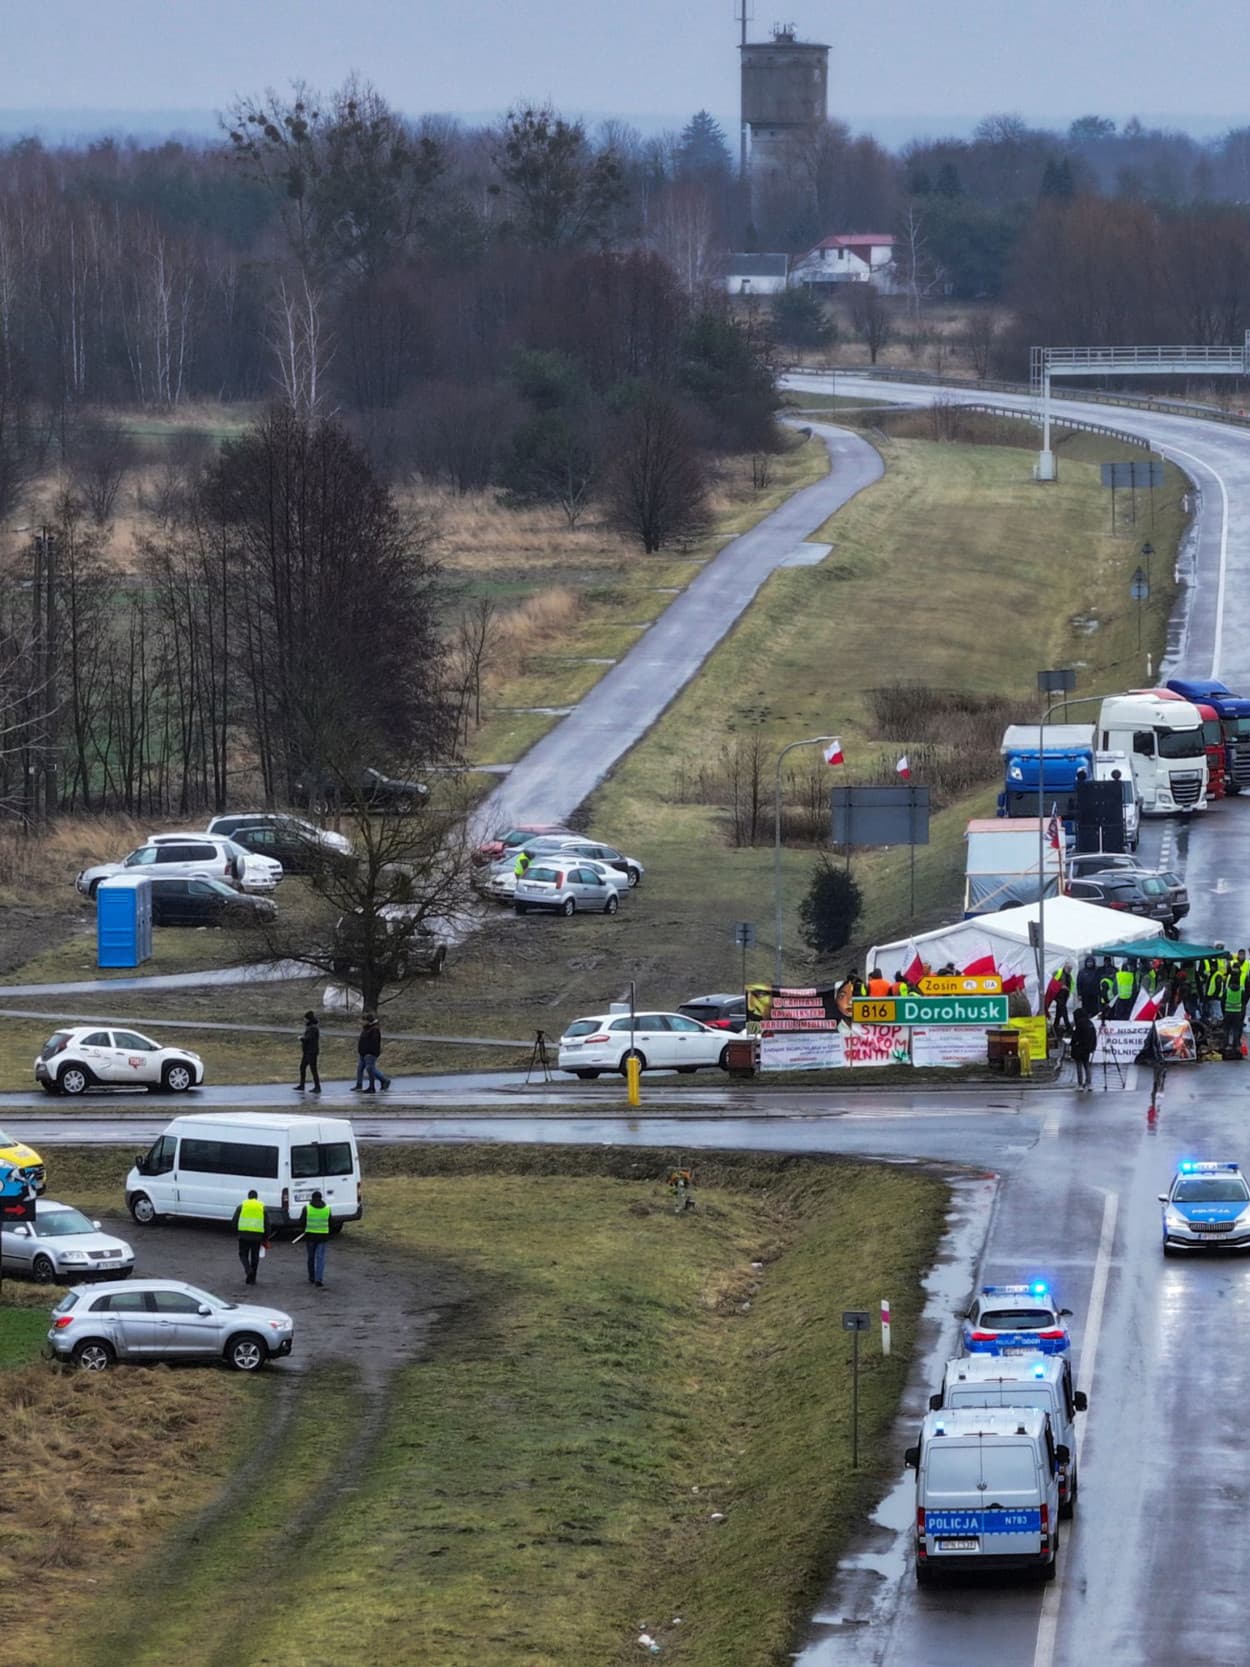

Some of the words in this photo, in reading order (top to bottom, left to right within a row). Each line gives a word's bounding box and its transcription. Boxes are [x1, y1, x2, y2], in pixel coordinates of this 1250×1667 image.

[925, 980, 957, 991] Zosin
[966, 981, 975, 989] PL
[862, 1005, 887, 1017] 816
[905, 1003, 1000, 1019] Dorohusk
[863, 1024, 902, 1037] STOP
[928, 1518, 978, 1529] POLICJA
